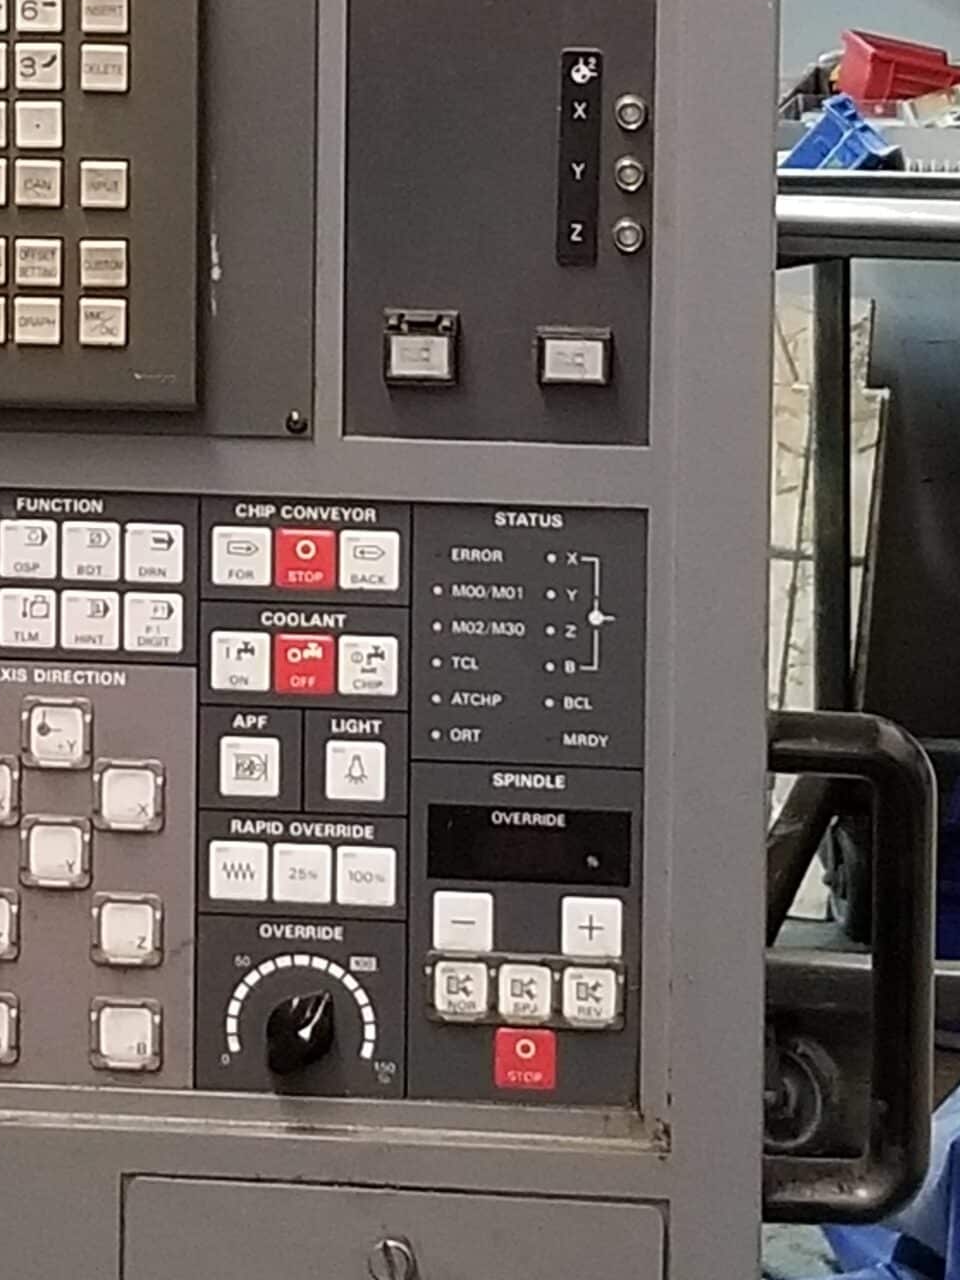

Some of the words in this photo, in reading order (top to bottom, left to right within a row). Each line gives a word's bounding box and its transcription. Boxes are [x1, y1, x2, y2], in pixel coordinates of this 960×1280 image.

[20, 0, 39, 21] 6
[19, 56, 37, 78] 3
[573, 101, 587, 119] X
[571, 163, 585, 180] Y
[570, 224, 583, 241] Z
[16, 497, 103, 513] FUNCTION
[236, 504, 276, 518] CHIP
[281, 505, 377, 522] CONVEYOR
[495, 512, 563, 528] STATUS
[451, 548, 503, 563] ERROR
[567, 552, 578, 565] X
[139, 567, 167, 578] DRN
[228, 570, 254, 580] FOR
[288, 571, 324, 583] STOP
[350, 574, 385, 584] BACK
[567, 589, 578, 601] Y
[261, 611, 347, 628] COOLANT
[13, 631, 40, 641] TLM
[565, 625, 577, 639] Z
[451, 656, 479, 670] TCL
[565, 660, 575, 674] B
[34, 669, 127, 686] DIRECTION
[229, 675, 249, 686] ON
[290, 676, 316, 687] OFF
[353, 679, 383, 690] CHIP
[451, 692, 503, 706] ATCHP
[564, 696, 592, 710] BCL
[331, 719, 383, 734] LIGHT
[450, 728, 482, 743] ORT
[563, 733, 609, 748] MRDY
[492, 772, 566, 789] SPINDLE
[491, 811, 566, 827] OVERRIDE
[230, 819, 283, 835] RAPID
[290, 823, 374, 839] OVERRIDE
[259, 924, 344, 941] OVERRIDE
[507, 1071, 542, 1082] STOP
